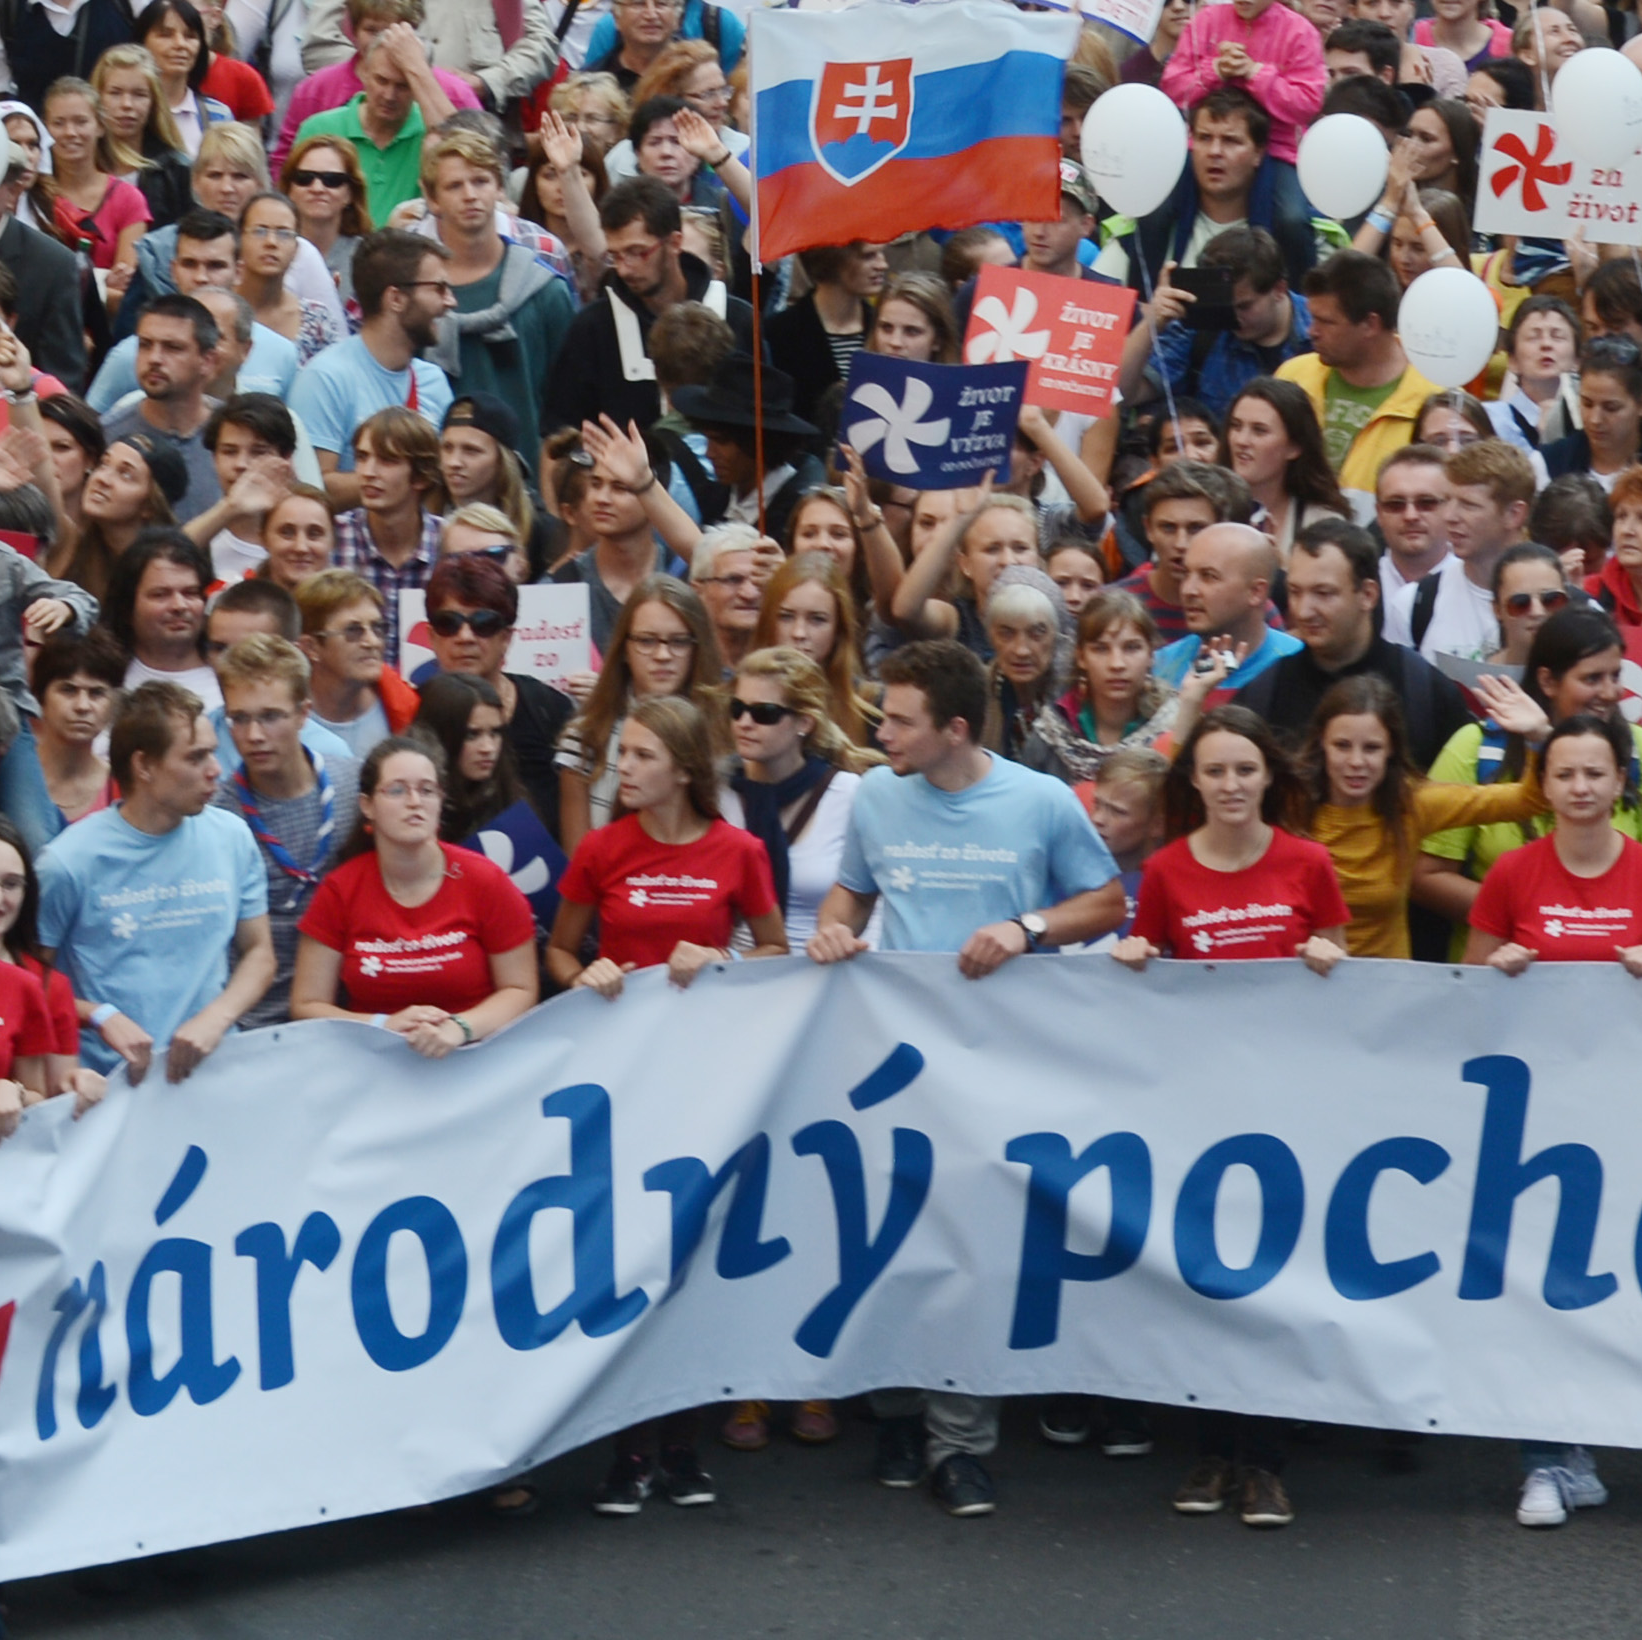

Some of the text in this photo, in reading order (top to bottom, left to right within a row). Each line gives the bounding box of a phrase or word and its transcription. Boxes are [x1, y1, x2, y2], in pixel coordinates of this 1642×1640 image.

[1590, 166, 1624, 189] za
[1565, 195, 1641, 224] život
[1059, 301, 1119, 330] ŽIVOT
[1069, 330, 1096, 351] JE
[958, 386, 1016, 407] ŽIVOT
[970, 410, 995, 431] JE
[950, 432, 1007, 454] VÝZVA
[36, 1043, 933, 1440] národný
